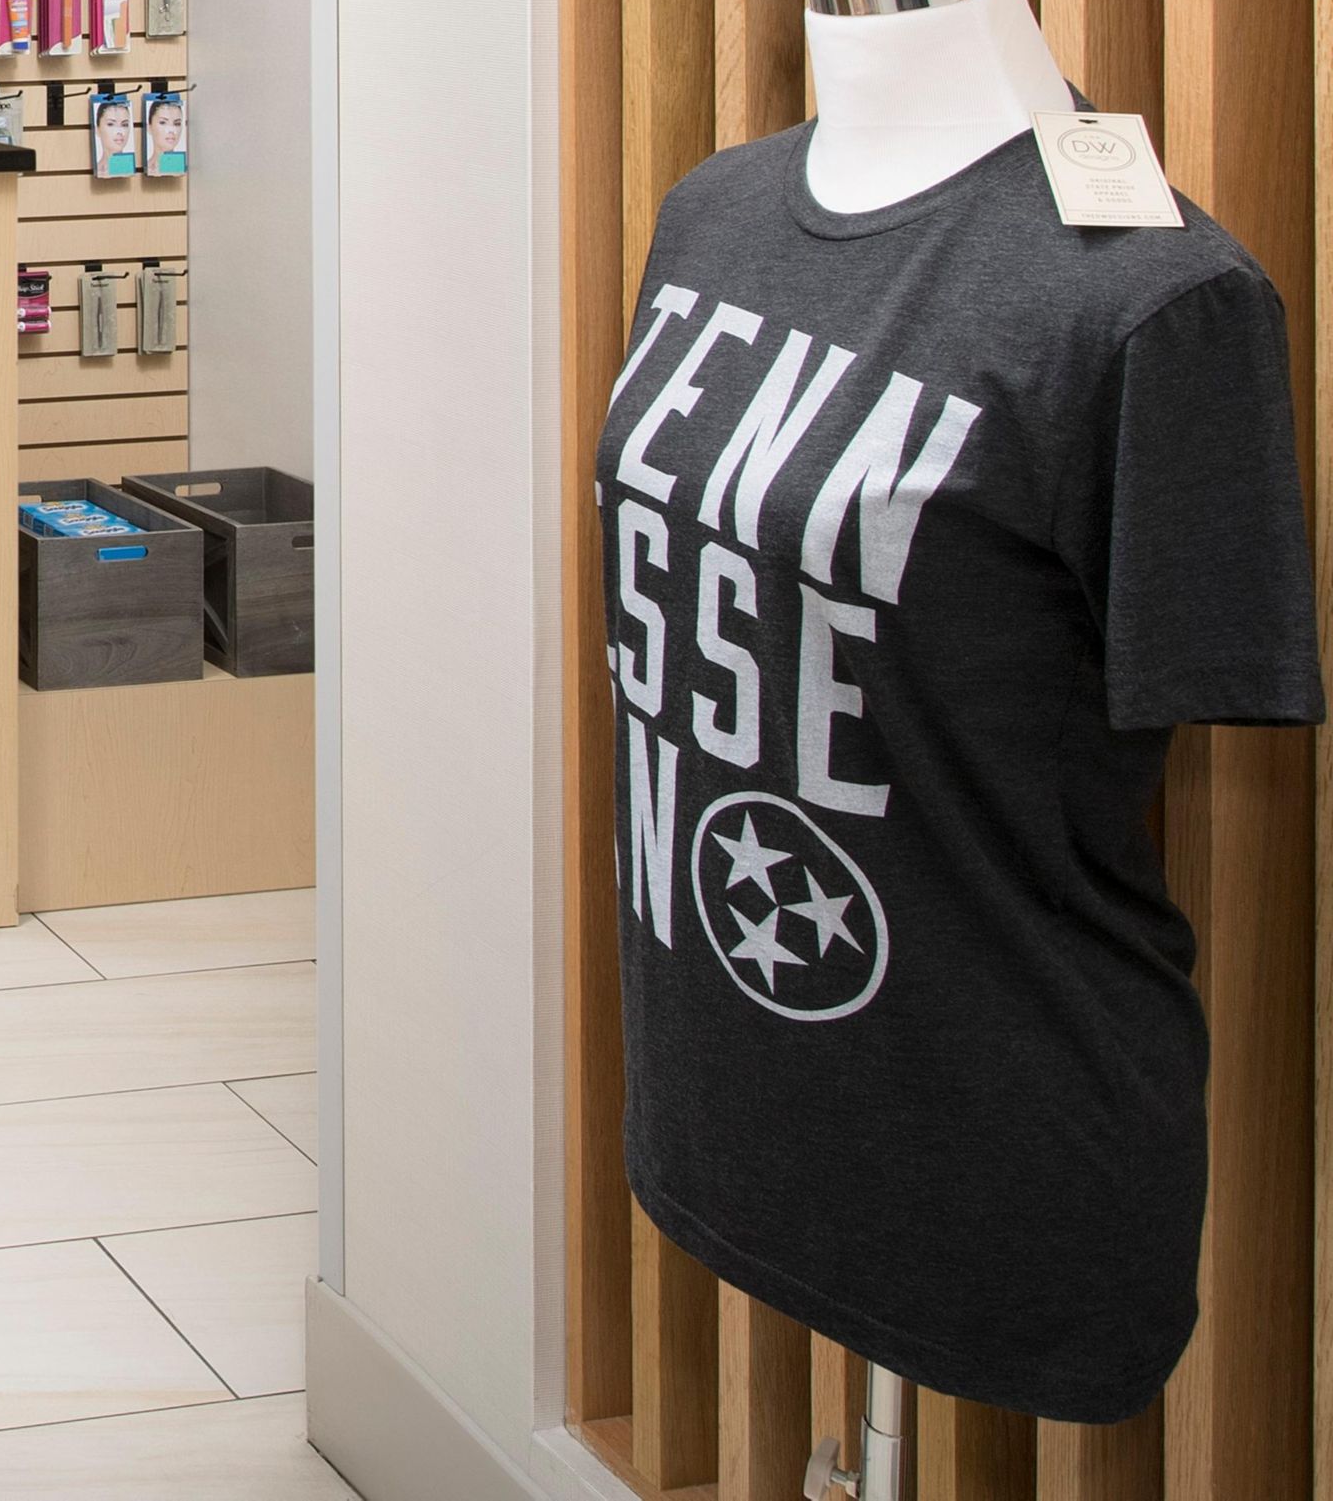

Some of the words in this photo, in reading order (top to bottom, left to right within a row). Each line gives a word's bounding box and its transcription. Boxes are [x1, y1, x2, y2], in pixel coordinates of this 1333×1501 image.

[1072, 140, 1116, 154] DW
[610, 283, 983, 606] TENN
[597, 490, 890, 818] SSE
